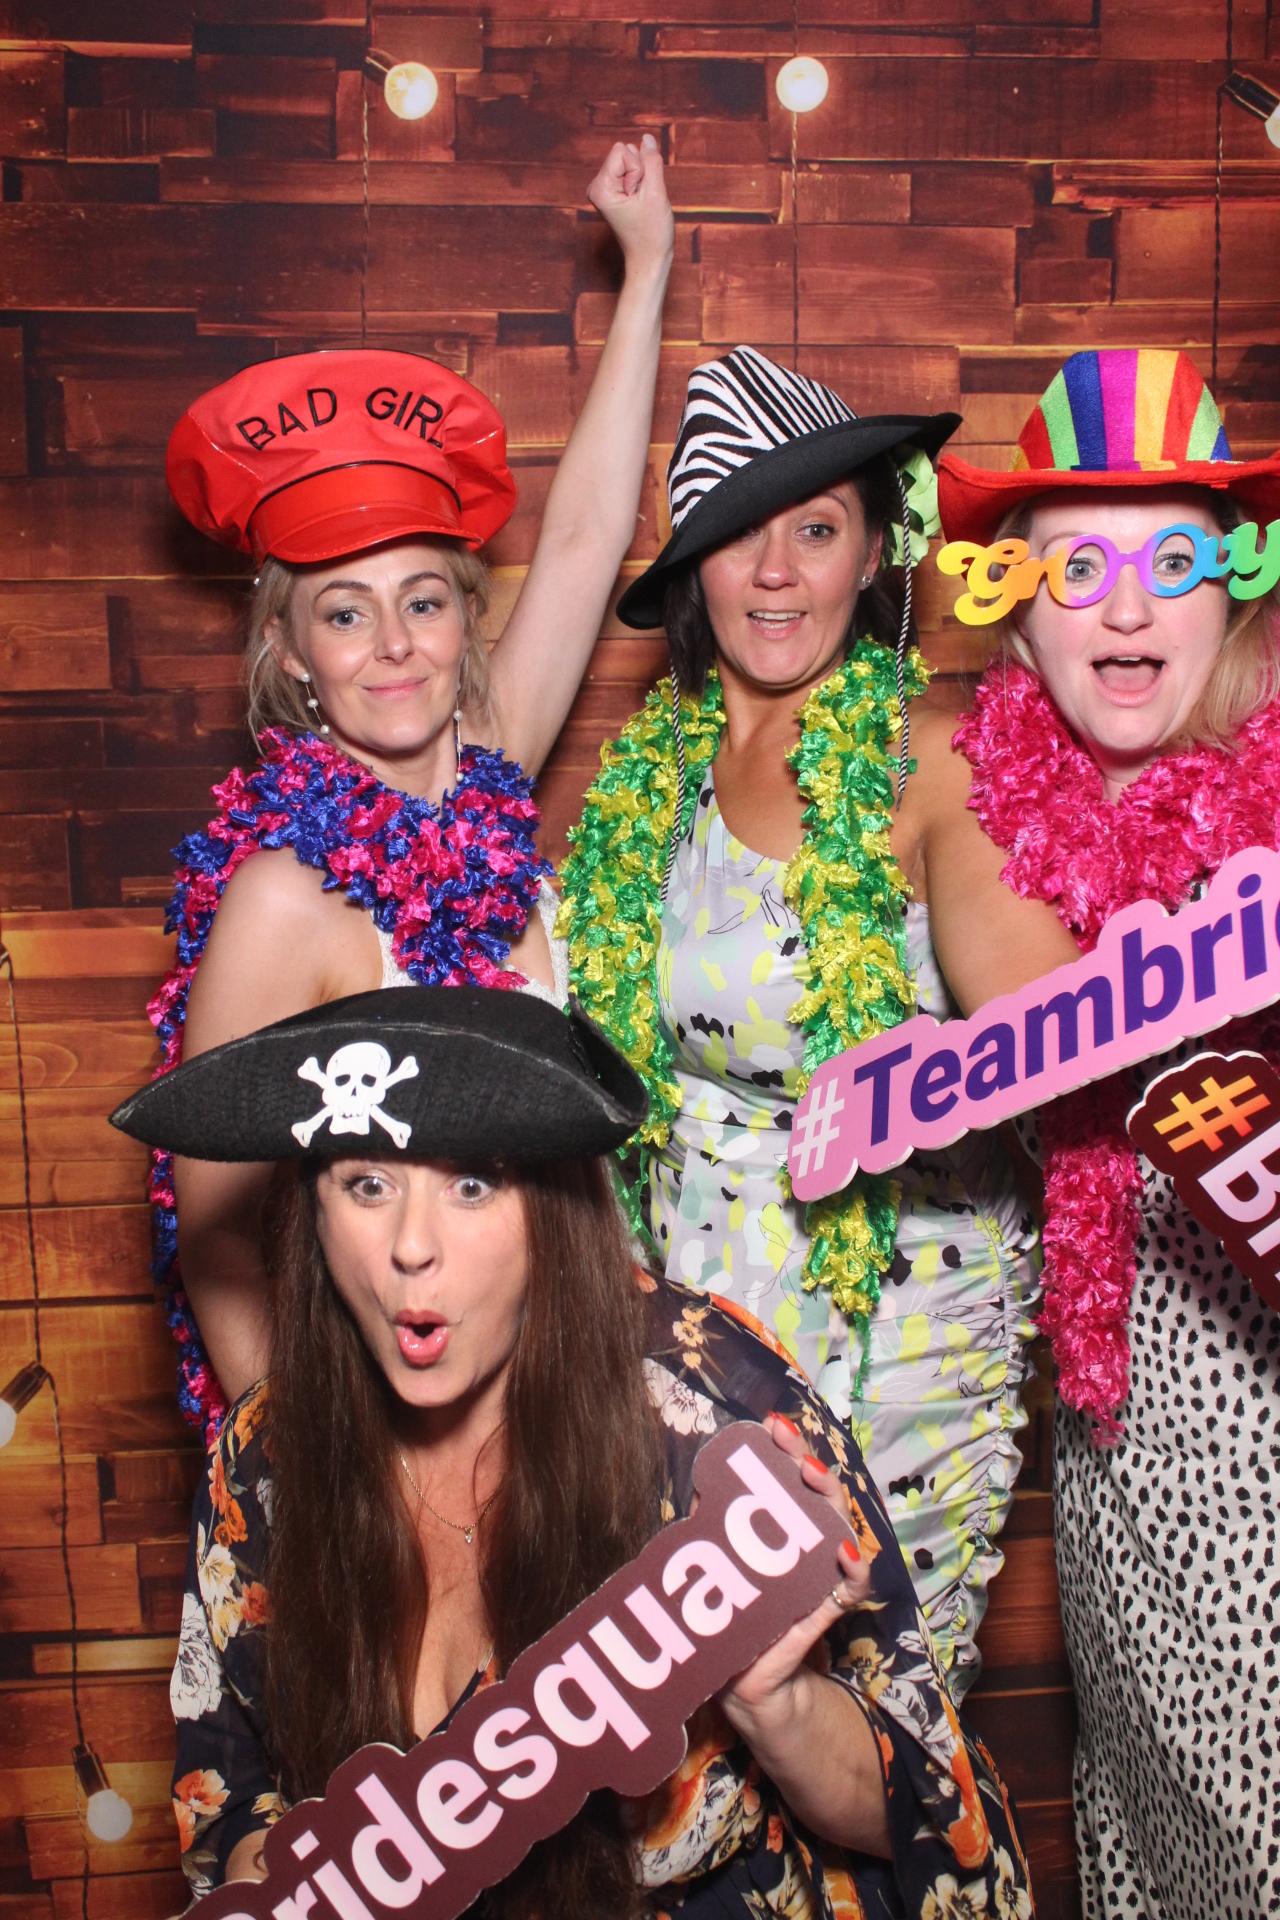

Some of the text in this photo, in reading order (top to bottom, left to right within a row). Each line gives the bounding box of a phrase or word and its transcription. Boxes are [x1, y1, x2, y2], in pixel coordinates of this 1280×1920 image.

[236, 387, 338, 450] BAD
[791, 873, 1280, 1178] #Teambri
[218, 1445, 824, 1920] ridesquad
